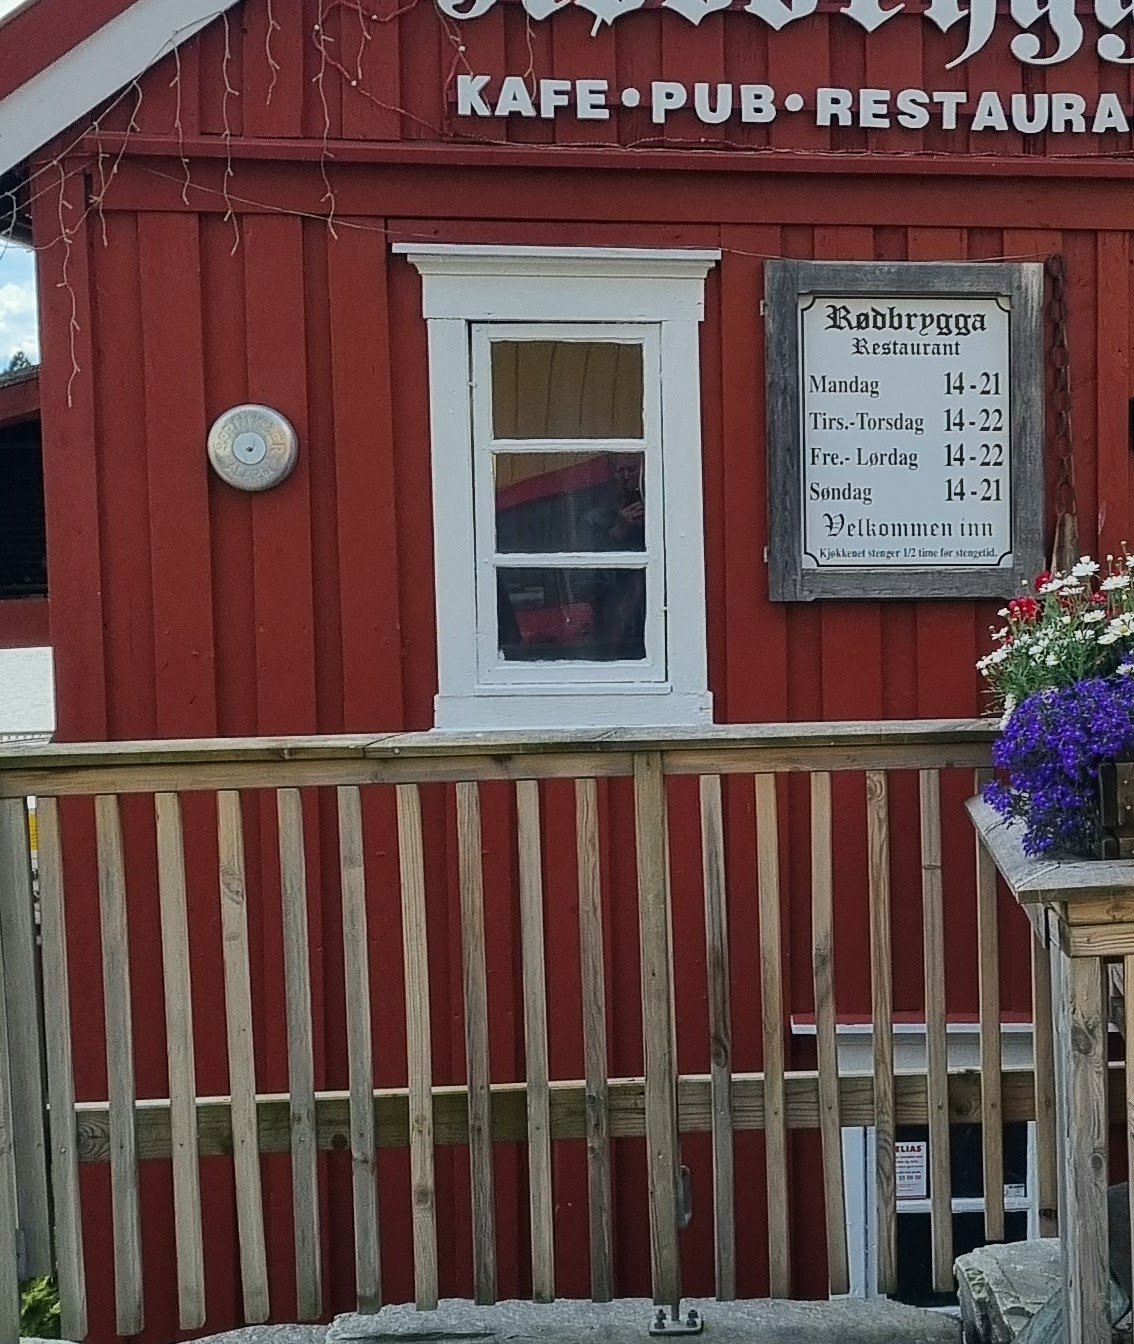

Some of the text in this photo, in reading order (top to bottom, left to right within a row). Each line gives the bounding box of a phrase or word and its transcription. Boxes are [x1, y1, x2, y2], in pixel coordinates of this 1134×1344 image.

[457, 75, 609, 120] KAFE
[651, 82, 776, 124] PUB
[825, 305, 987, 337] Rødbrygga
[852, 337, 961, 356] Restaurant
[809, 375, 880, 398] Mandag
[857, 447, 919, 470] Lørdag
[809, 482, 873, 505] Søndag
[823, 513, 993, 537] Velkommen inn
